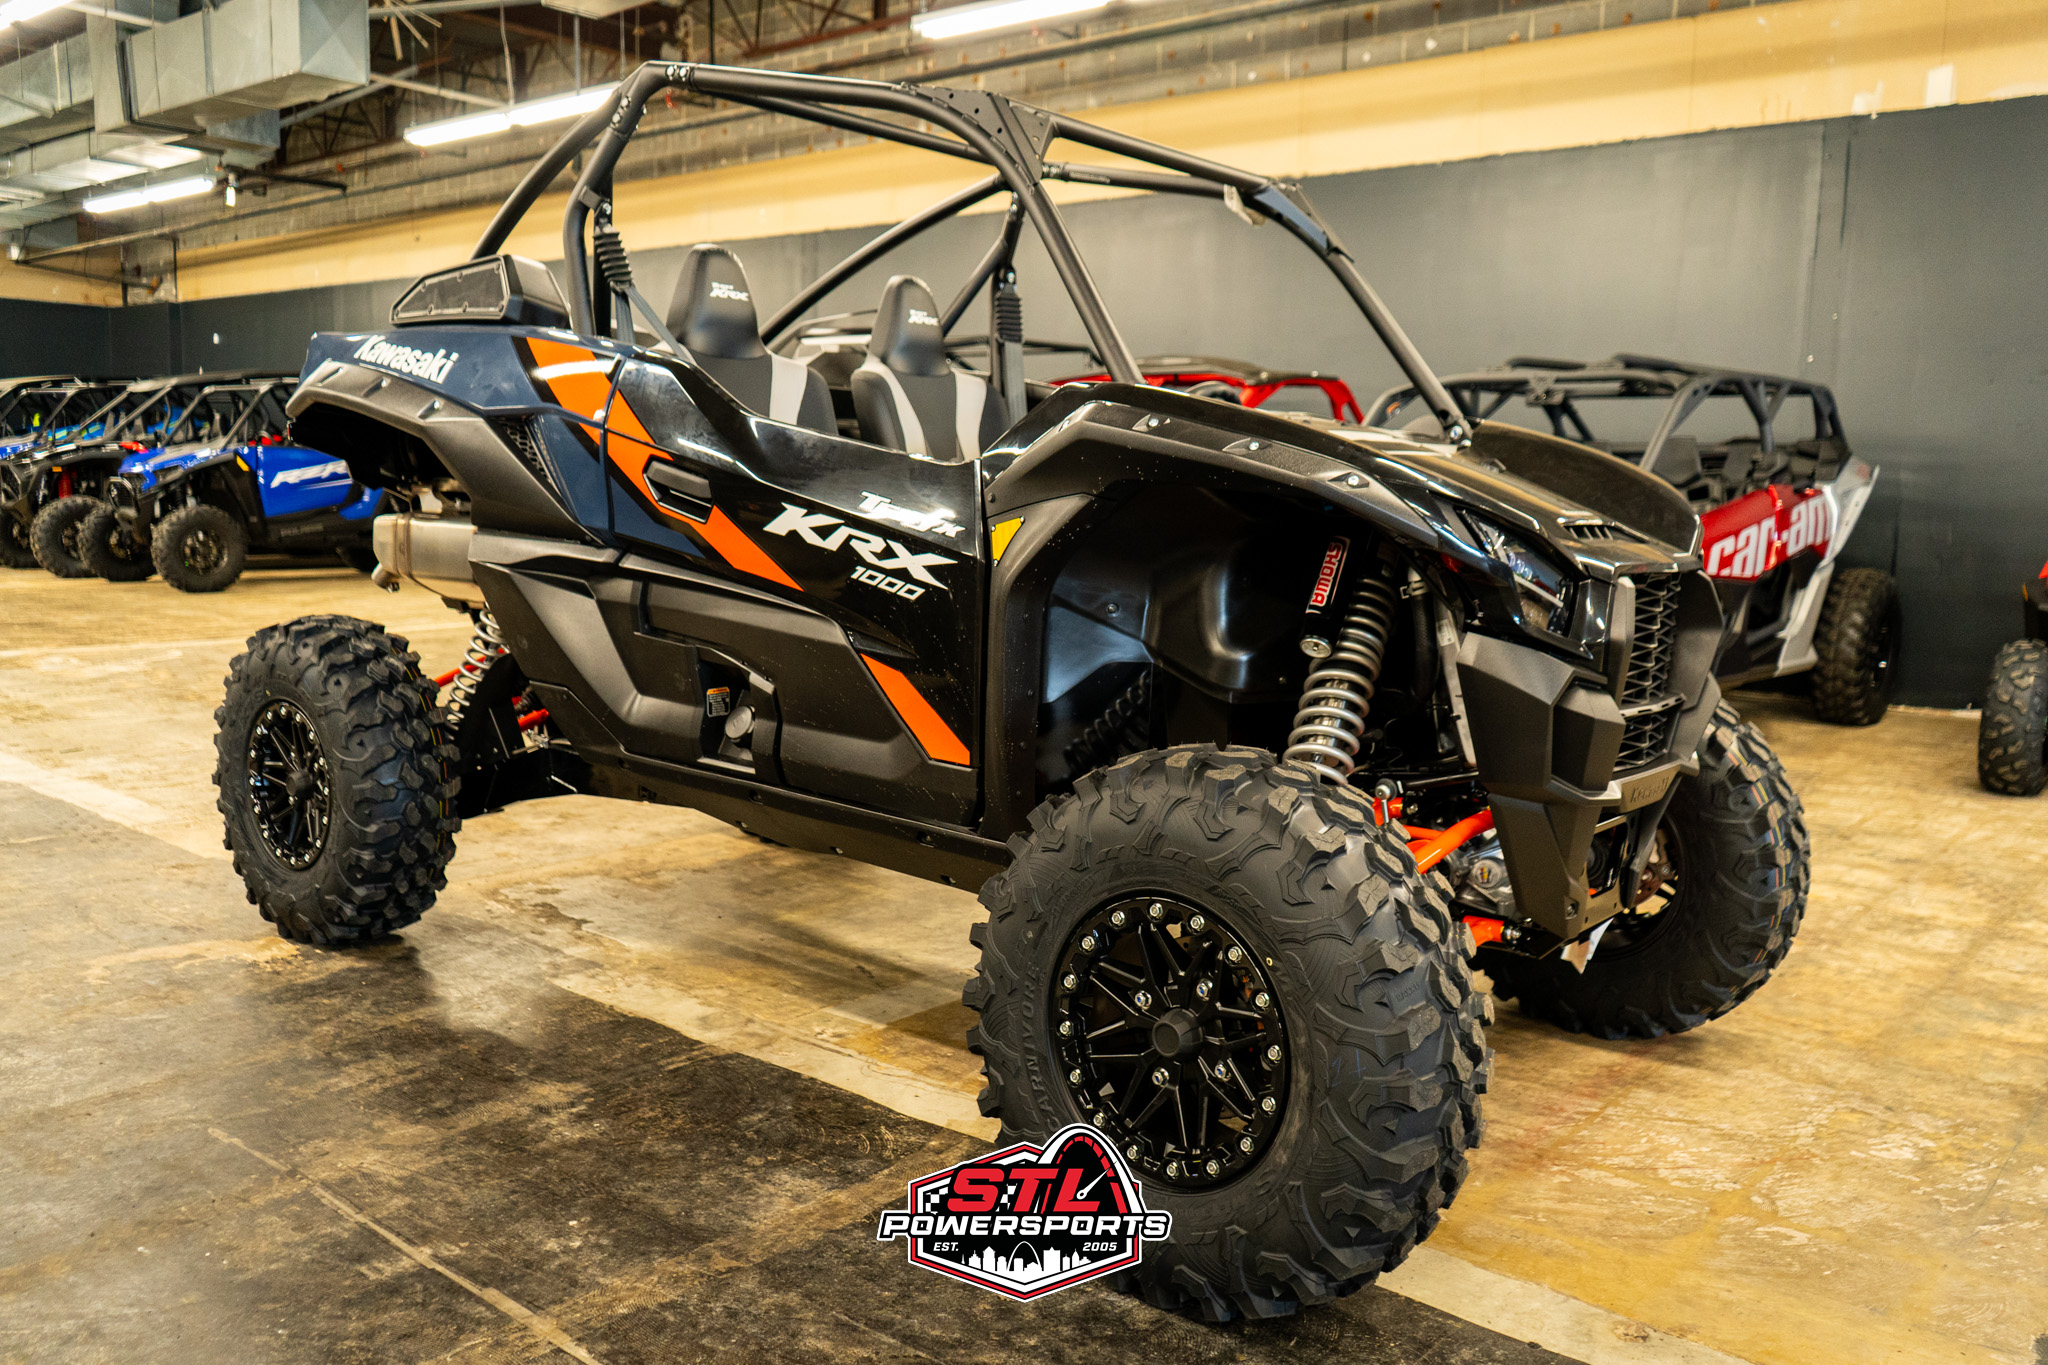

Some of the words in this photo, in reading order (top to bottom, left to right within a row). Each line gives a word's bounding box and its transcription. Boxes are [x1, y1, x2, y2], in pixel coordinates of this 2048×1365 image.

[353, 334, 460, 384] Kawasaki
[763, 501, 959, 591] KRX
[1309, 542, 1343, 608] SHOWA
[850, 565, 926, 600] 1000
